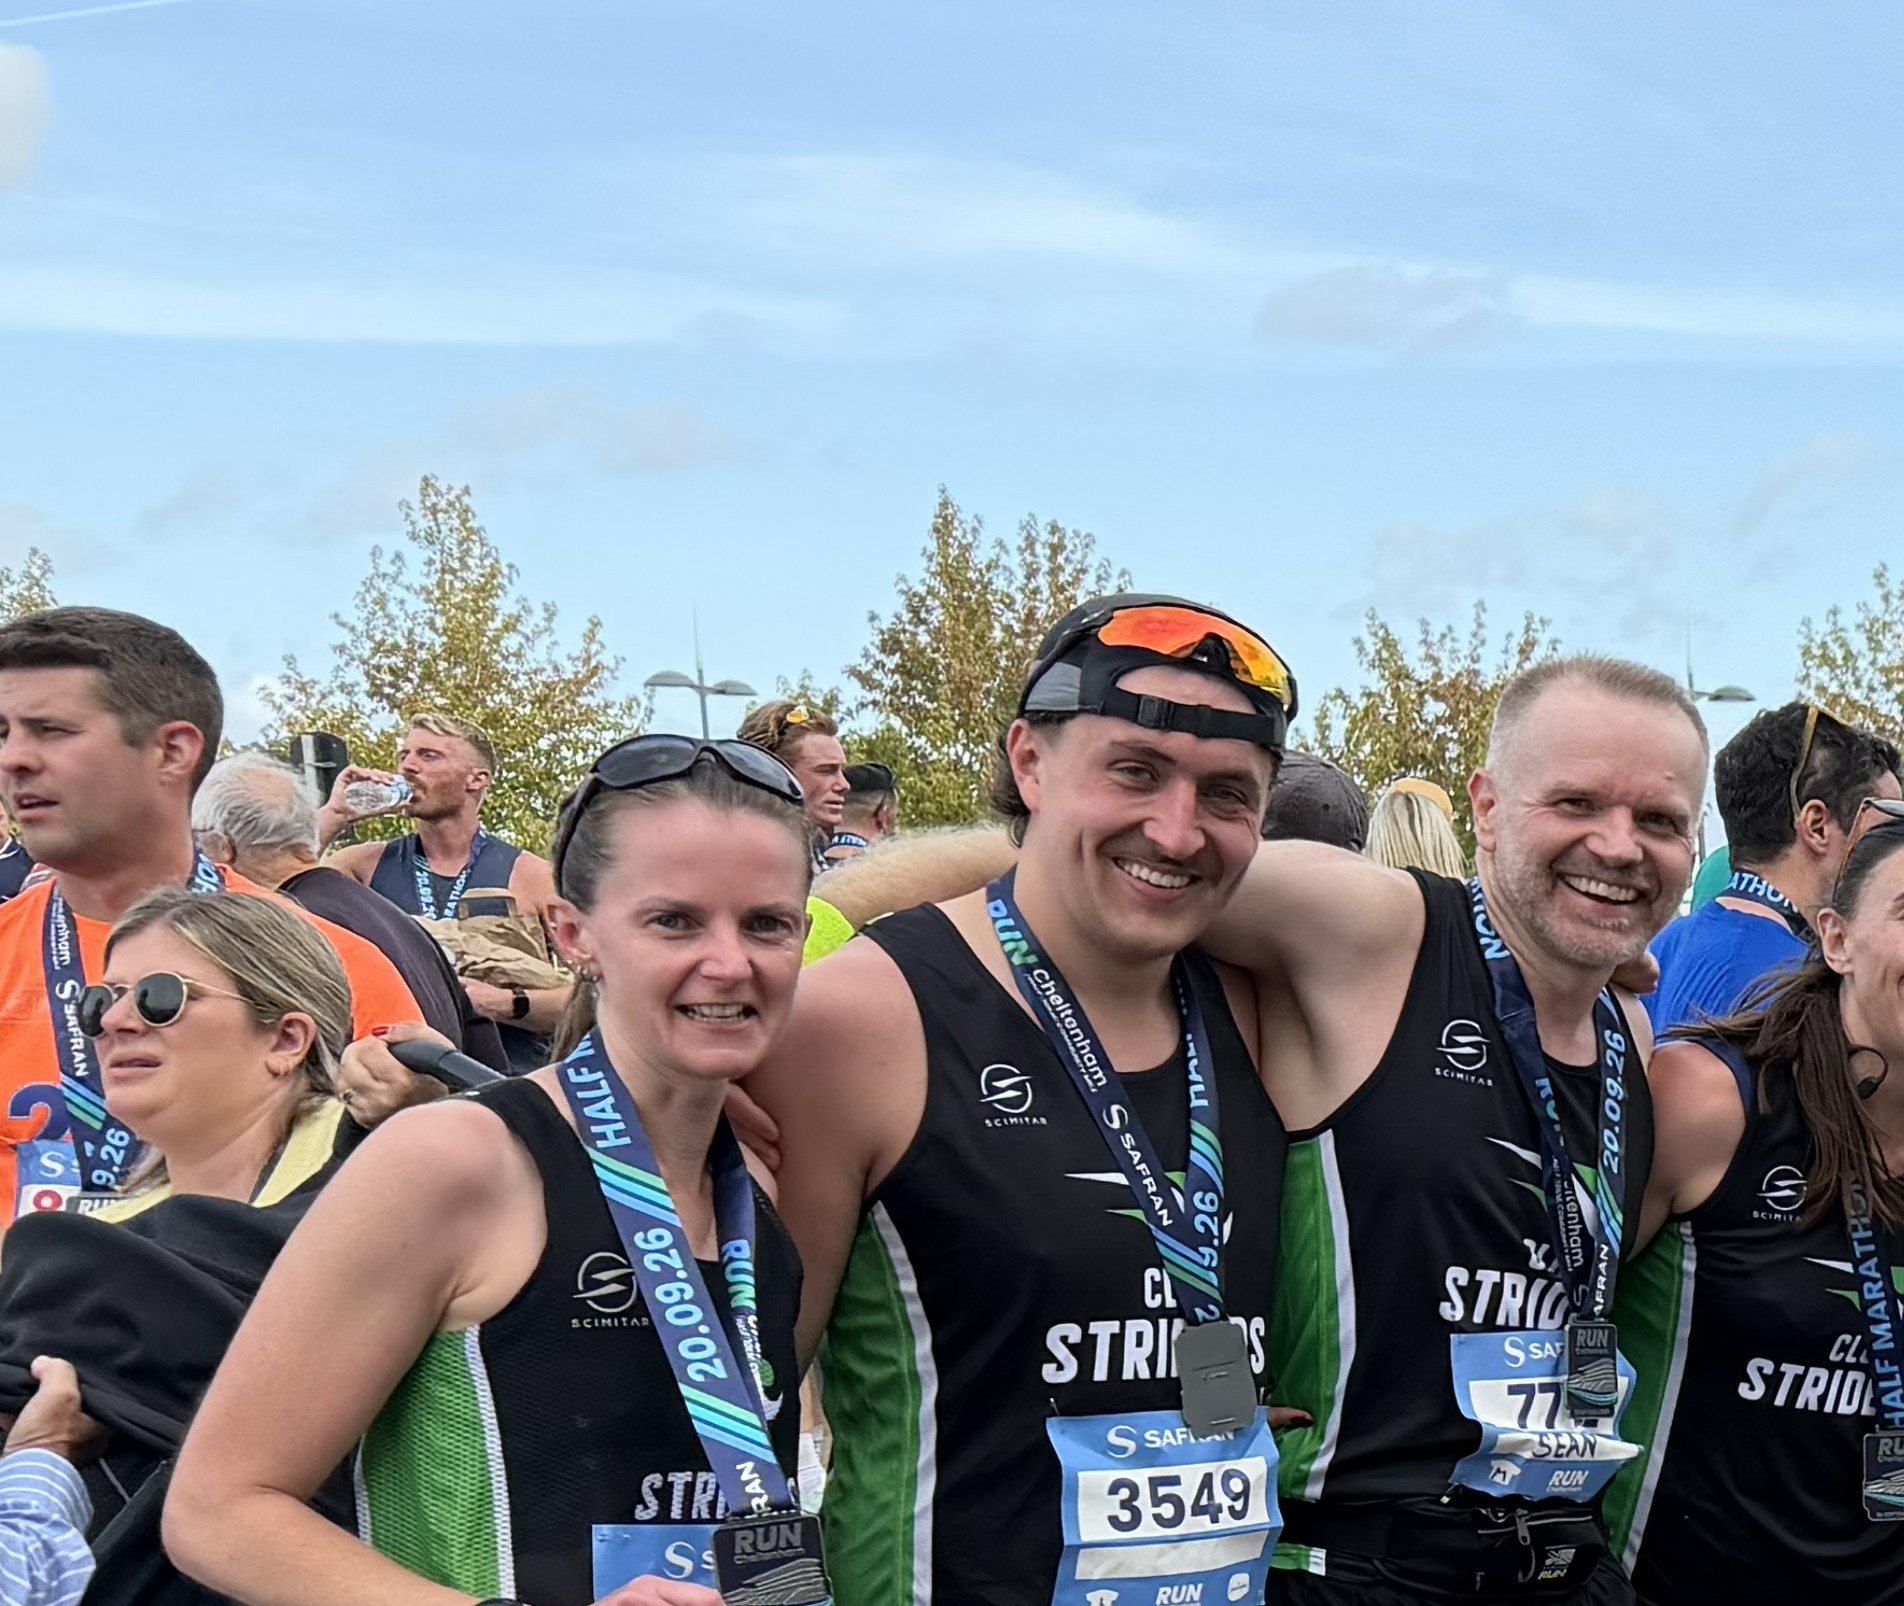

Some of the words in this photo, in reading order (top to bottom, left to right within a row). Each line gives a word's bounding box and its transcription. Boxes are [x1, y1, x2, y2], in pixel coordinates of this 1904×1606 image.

[1032, 968, 1107, 1087] Cheltenham
[567, 1066, 632, 1149] HALF
[1603, 1029, 1626, 1175] 20.09.26
[91, 1128, 130, 1187] 9.26
[1120, 1132, 1173, 1227] SAFRAN
[1753, 1210, 1801, 1221] SCIMITA
[633, 1227, 730, 1382] 20.09.26
[1144, 1267, 1181, 1308] CL
[1439, 1265, 1570, 1330] STRID
[1041, 1316, 1265, 1384] STRIS
[1529, 1342, 1564, 1360] SAF
[1738, 1357, 1876, 1416] STRID
[1533, 1434, 1598, 1459] SEAN
[1551, 1469, 1589, 1486] RUN
[1107, 1467, 1252, 1533] 3549
[1154, 1583, 1205, 1606] RUN
